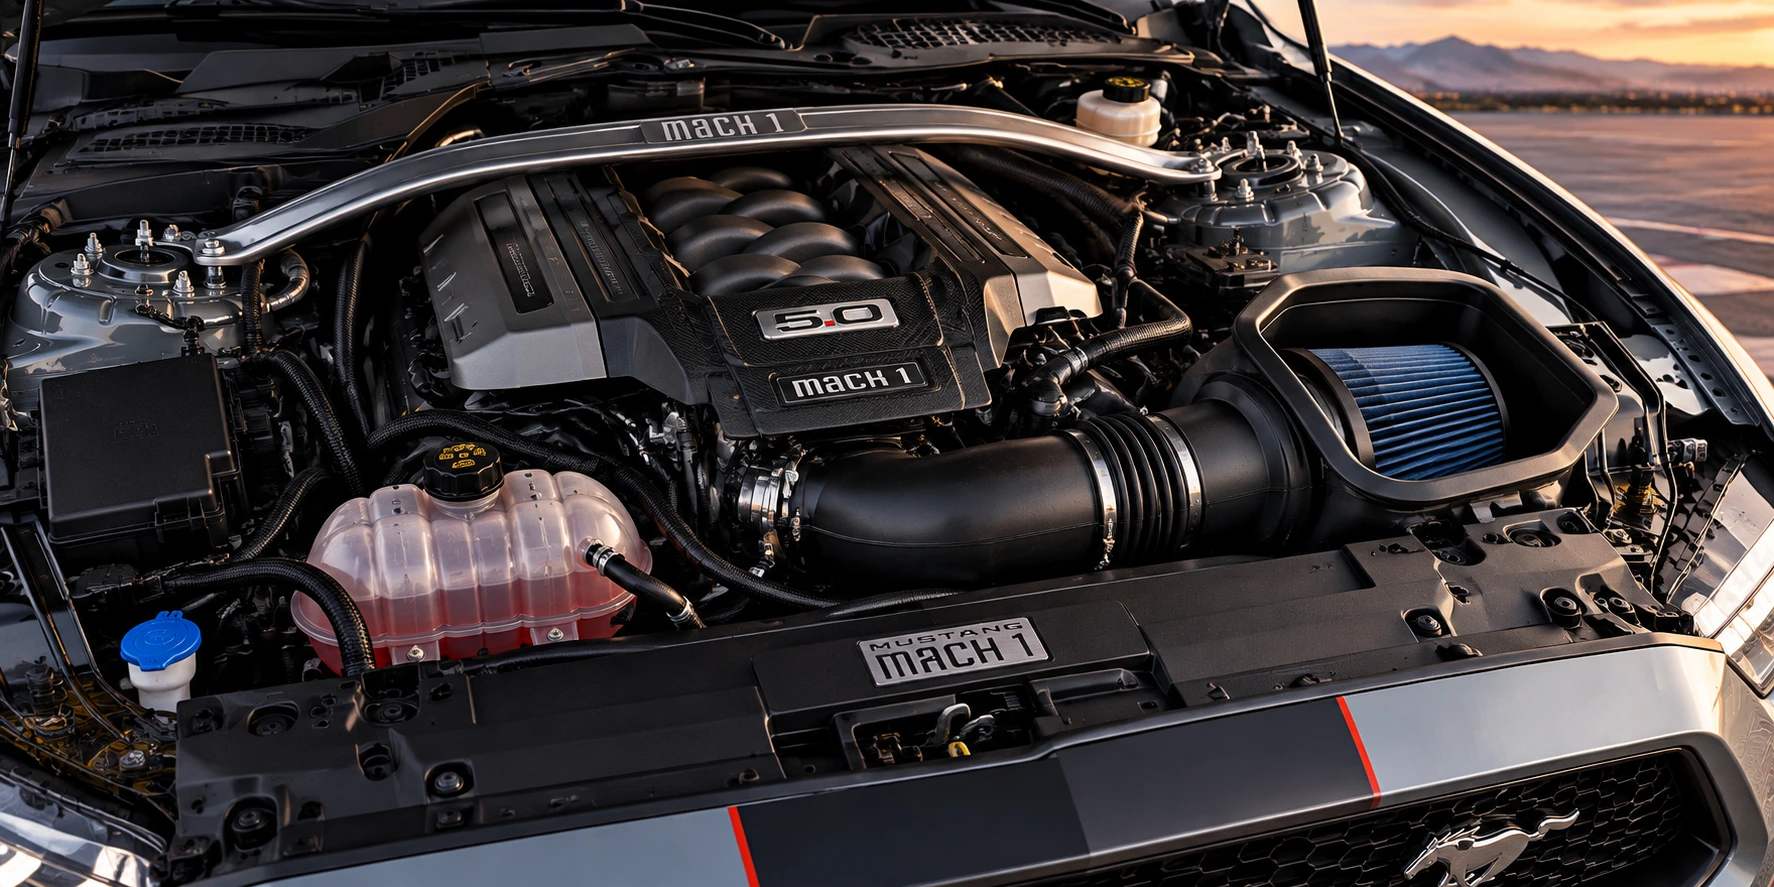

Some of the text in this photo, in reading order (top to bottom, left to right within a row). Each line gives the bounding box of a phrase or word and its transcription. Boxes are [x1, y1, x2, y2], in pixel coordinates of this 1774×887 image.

[765, 113, 784, 132] 1
[774, 304, 884, 332] 5.0
[895, 367, 912, 384] 1
[869, 622, 1024, 652] MUSTANG
[1011, 632, 1034, 657] 1
